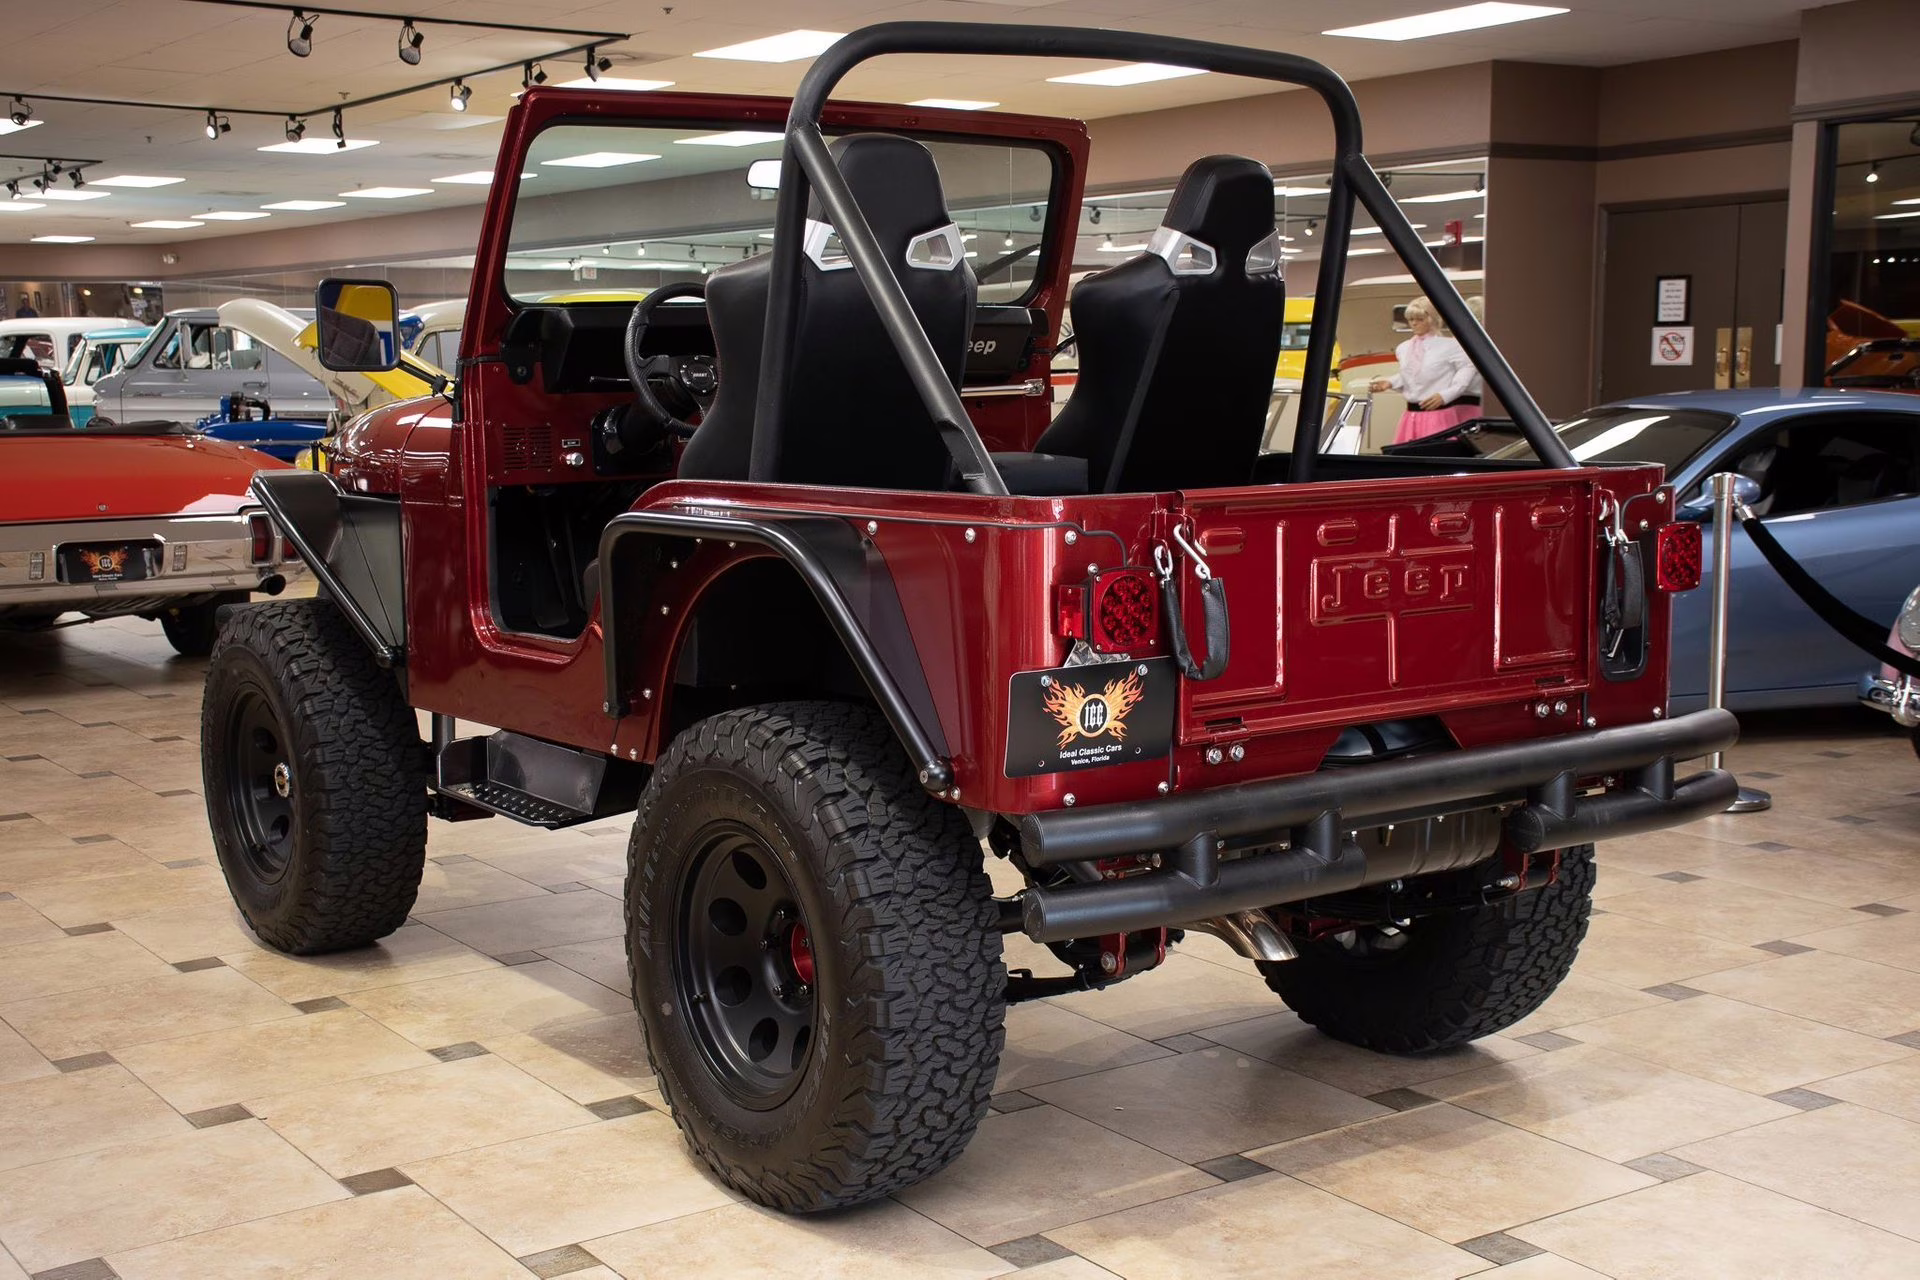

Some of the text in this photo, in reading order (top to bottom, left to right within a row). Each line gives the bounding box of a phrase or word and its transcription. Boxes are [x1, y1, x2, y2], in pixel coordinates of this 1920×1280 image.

[1321, 564, 1469, 613] Jeep
[1059, 743, 1123, 759] Ideal Classic Cars
[1070, 754, 1110, 766] Venice, Florida
